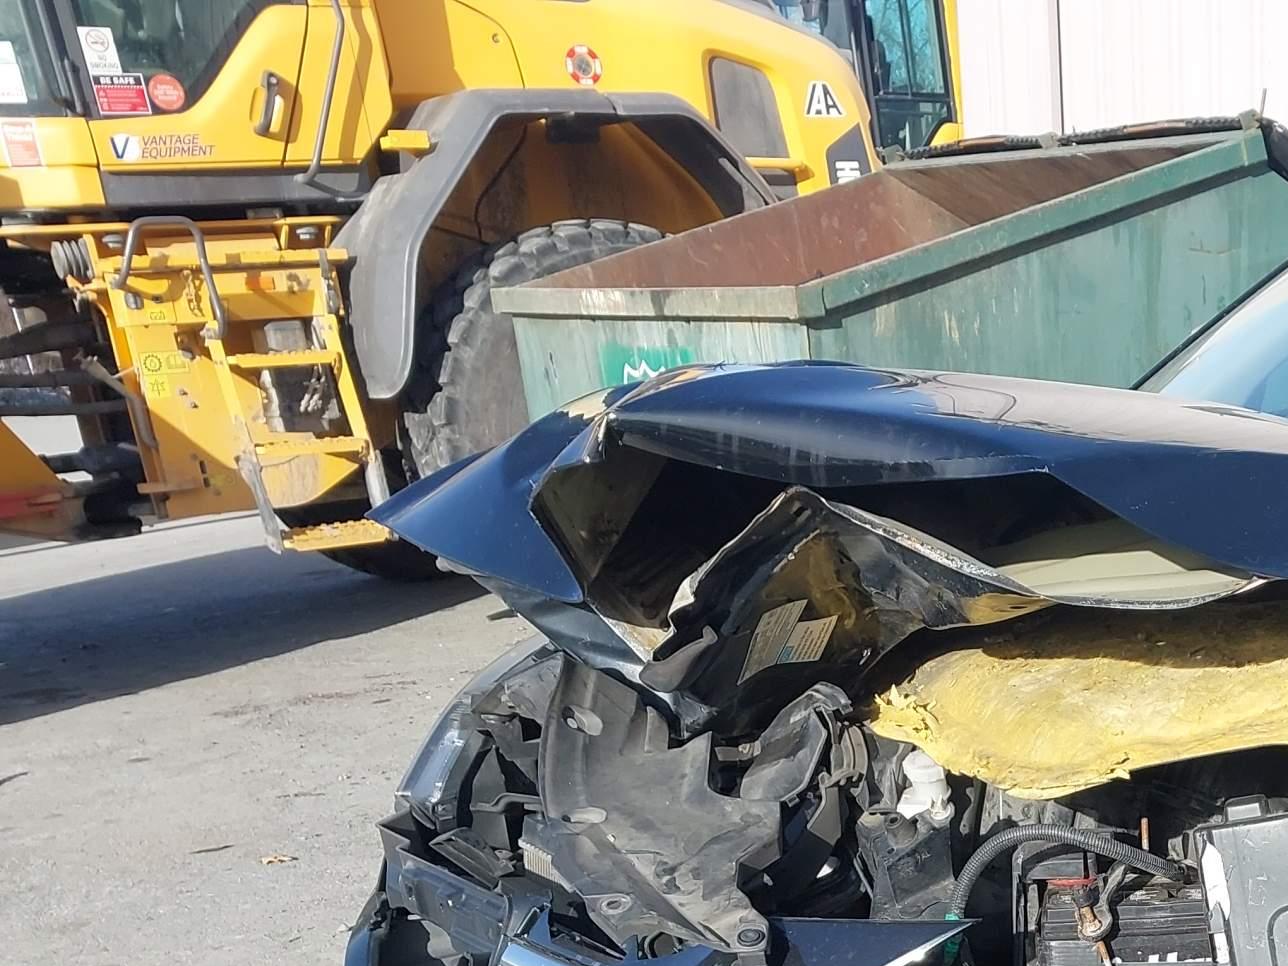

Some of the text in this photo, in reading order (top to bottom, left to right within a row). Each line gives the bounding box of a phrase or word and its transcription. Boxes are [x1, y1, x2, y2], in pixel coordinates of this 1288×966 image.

[99, 76, 136, 85] BE SAFE
[142, 134, 200, 146] VANTAGE
[141, 145, 217, 159] EQUIPMENT
